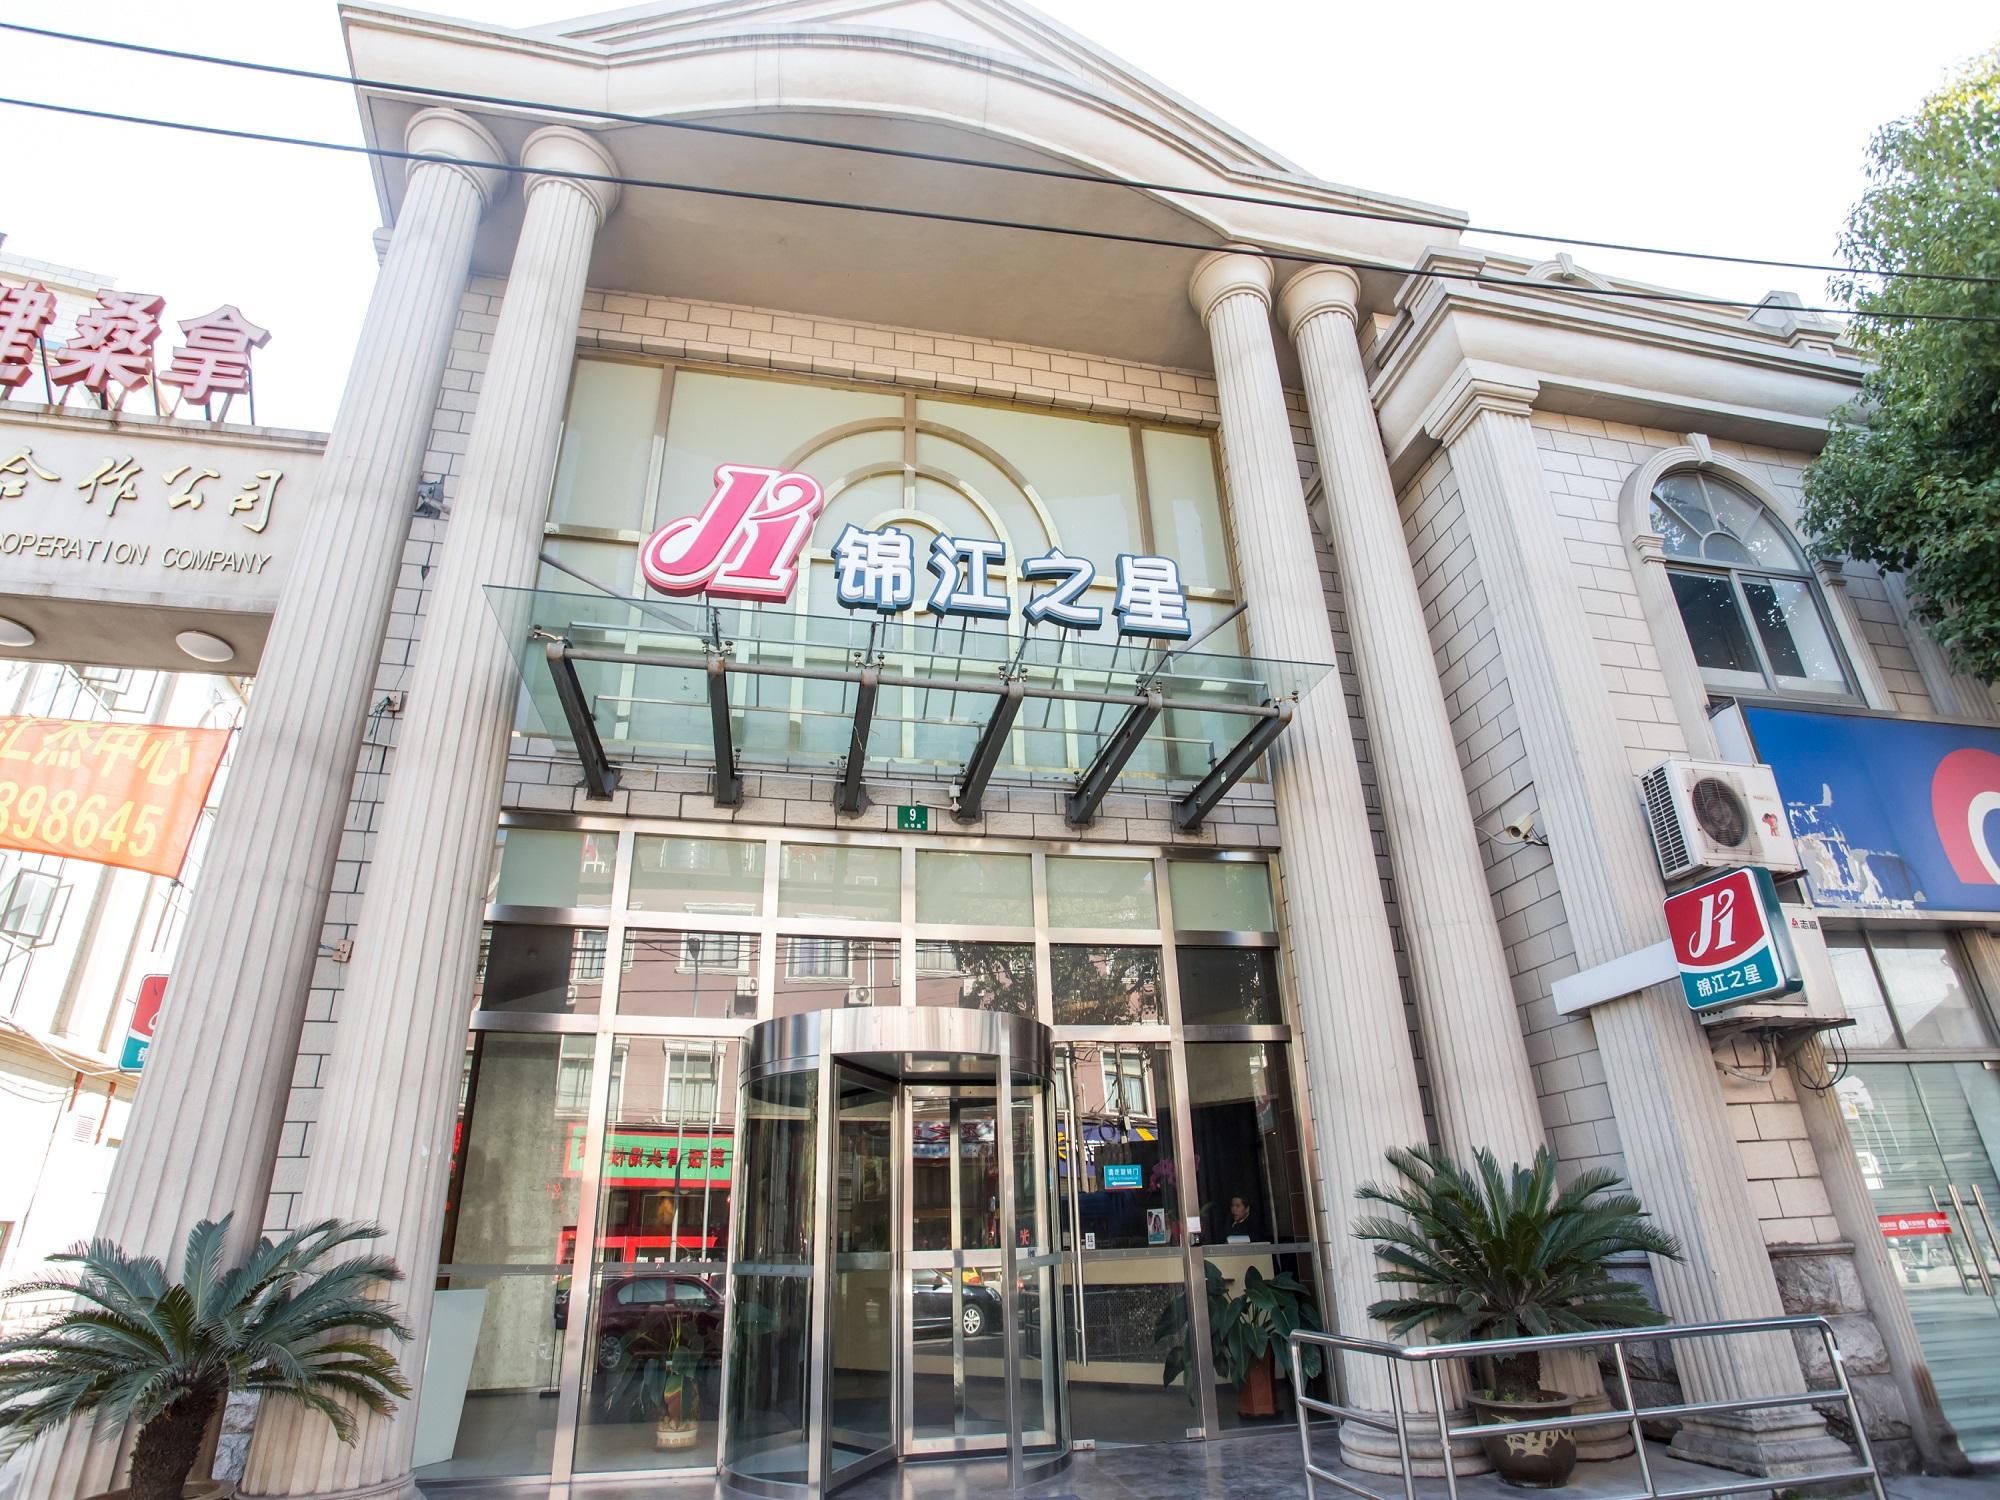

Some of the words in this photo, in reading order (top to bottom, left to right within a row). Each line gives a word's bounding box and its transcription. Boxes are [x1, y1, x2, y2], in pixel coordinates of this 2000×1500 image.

[0, 532, 150, 566] OPERATION
[161, 547, 272, 574] COMPANY
[831, 522, 1192, 641] 锦江之星
[909, 808, 916, 821] 9
[1696, 964, 1762, 997] 锦江之星
